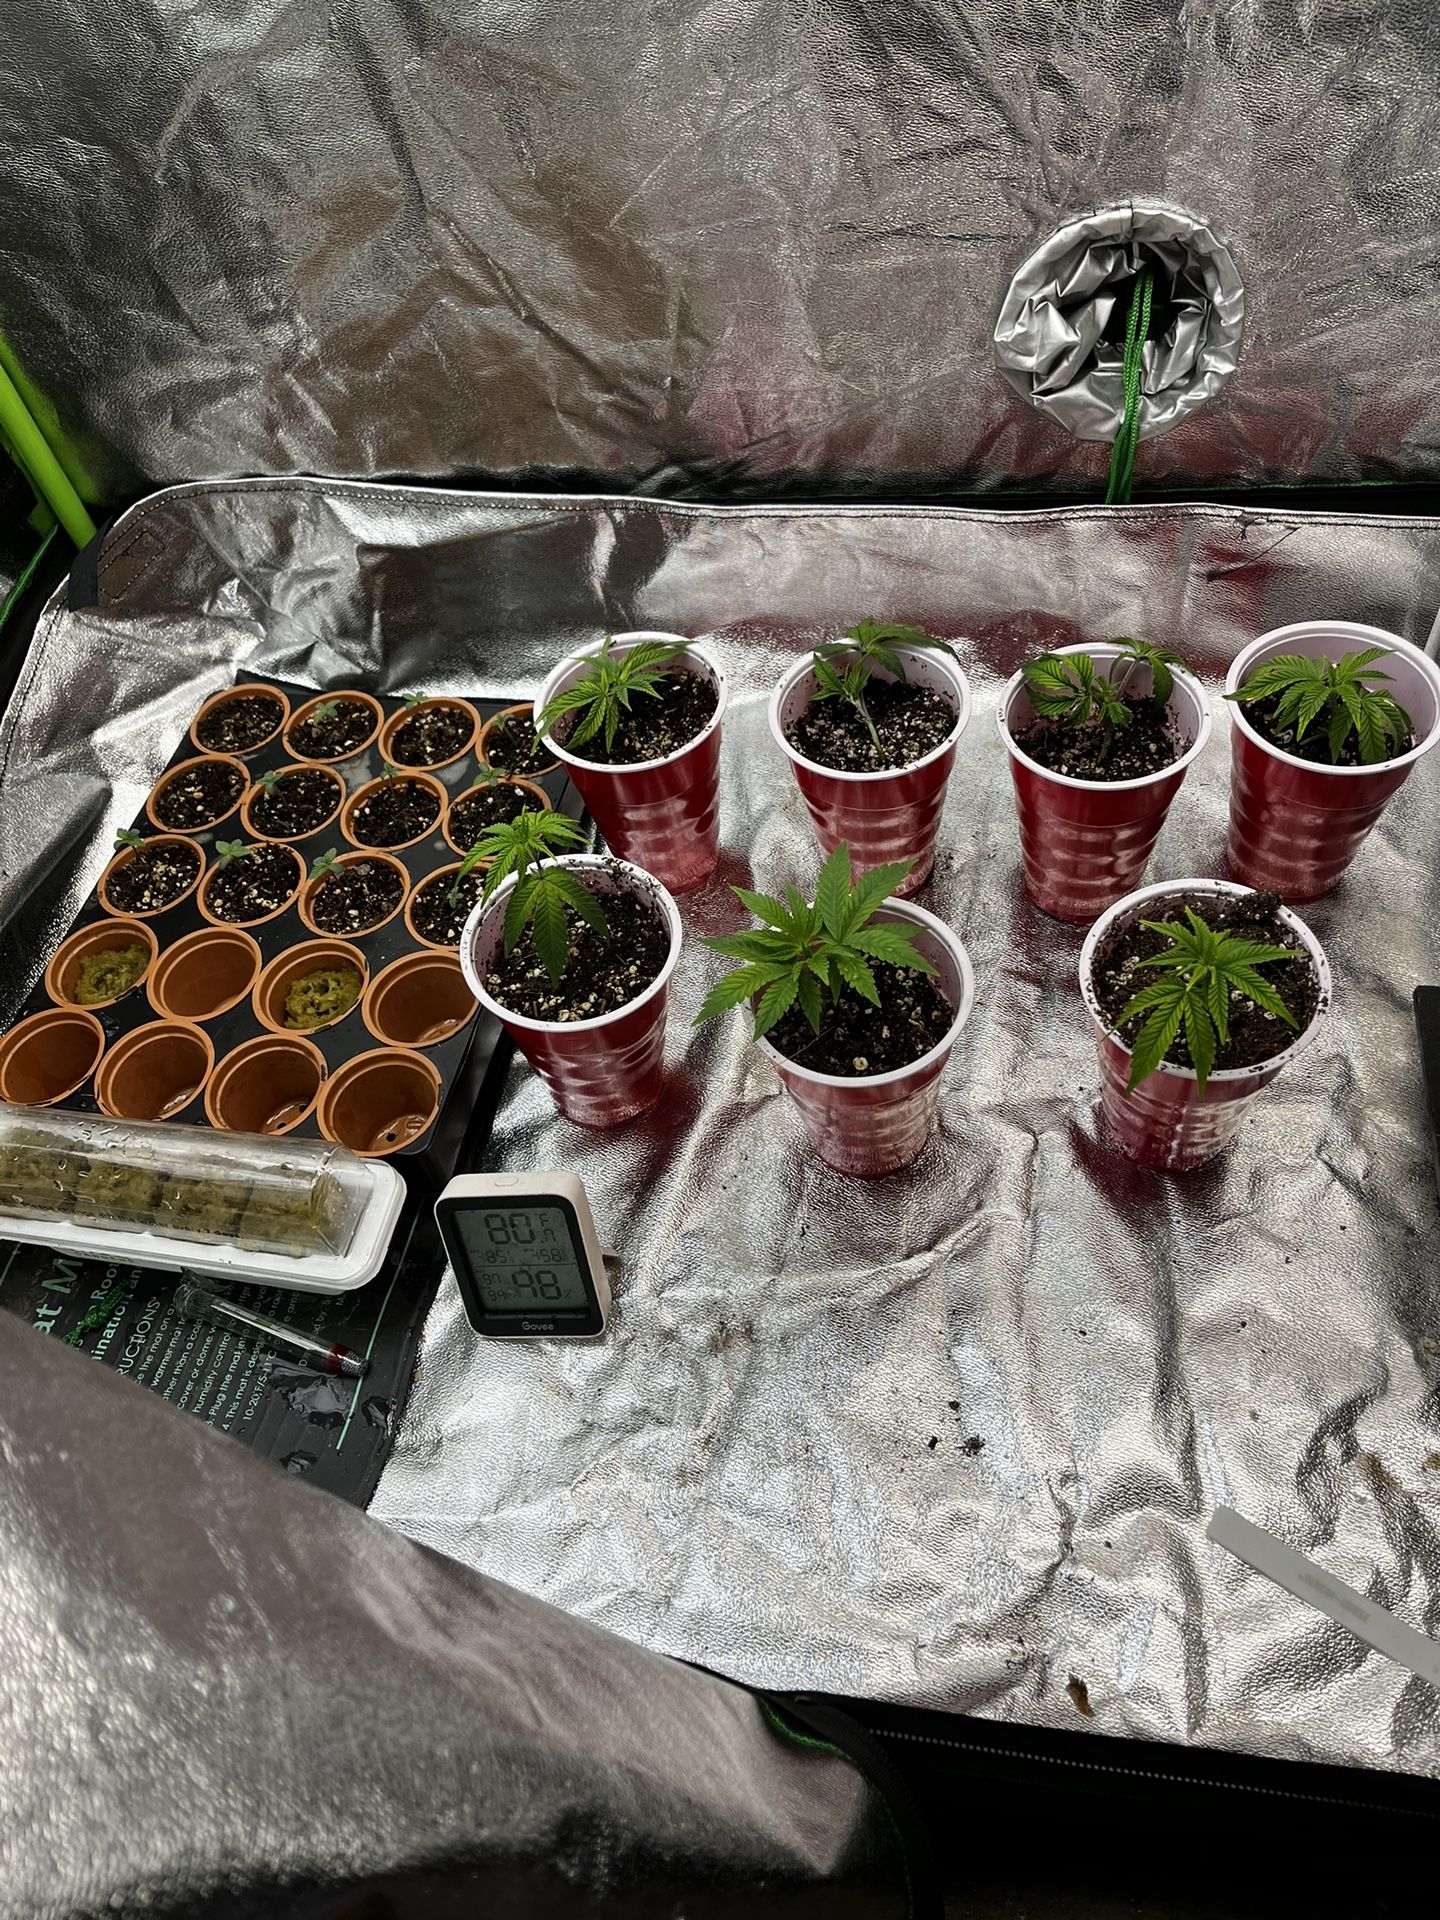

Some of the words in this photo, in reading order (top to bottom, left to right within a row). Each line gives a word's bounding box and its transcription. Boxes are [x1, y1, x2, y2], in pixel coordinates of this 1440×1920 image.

[41, 1258, 83, 1295] M
[31, 1303, 62, 1335] at
[90, 1294, 132, 1360] inatio
[521, 1320, 555, 1331] Govee
[114, 1301, 160, 1377] RUCTIONS
[138, 1354, 154, 1371] the
[149, 1332, 164, 1353] mat
[159, 1317, 171, 1331] on
[150, 1348, 173, 1387] warmer
[168, 1326, 183, 1348] mat
[172, 1351, 190, 1375] than
[185, 1341, 194, 1350] a
[176, 1379, 194, 1410] cover
[190, 1367, 200, 1379] or
[195, 1335, 213, 1367] dome
[191, 1369, 218, 1413] humidity
[212, 1331, 231, 1368] control
[241, 1369, 253, 1377] is
[208, 1392, 227, 1416] Plug
[218, 1373, 233, 1391] the
[228, 1350, 242, 1373] mat
[234, 1377, 248, 1400] mat
[221, 1421, 232, 1431] 4.
[224, 1401, 240, 1419] This
